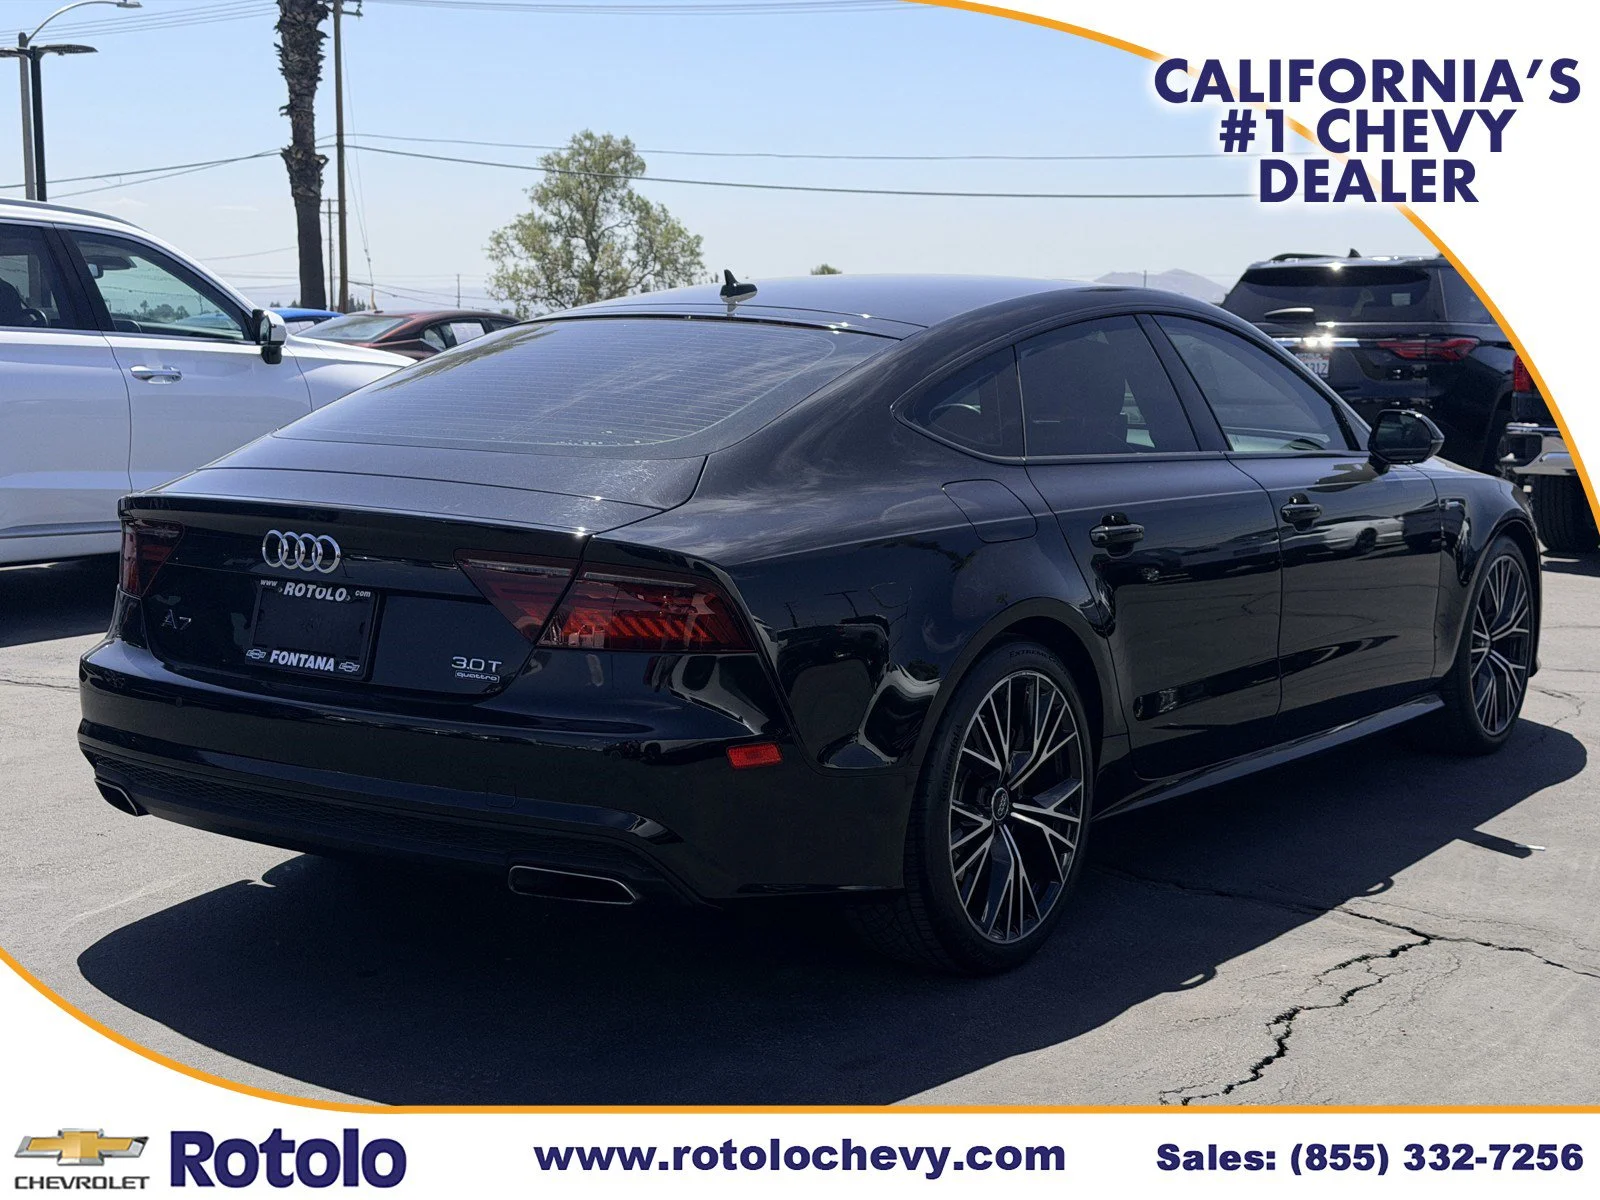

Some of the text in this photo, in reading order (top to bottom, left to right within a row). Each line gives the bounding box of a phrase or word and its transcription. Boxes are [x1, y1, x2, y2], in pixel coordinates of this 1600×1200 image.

[161, 608, 192, 630] A7
[269, 649, 335, 672] FONTANA
[456, 671, 498, 682] quattro
